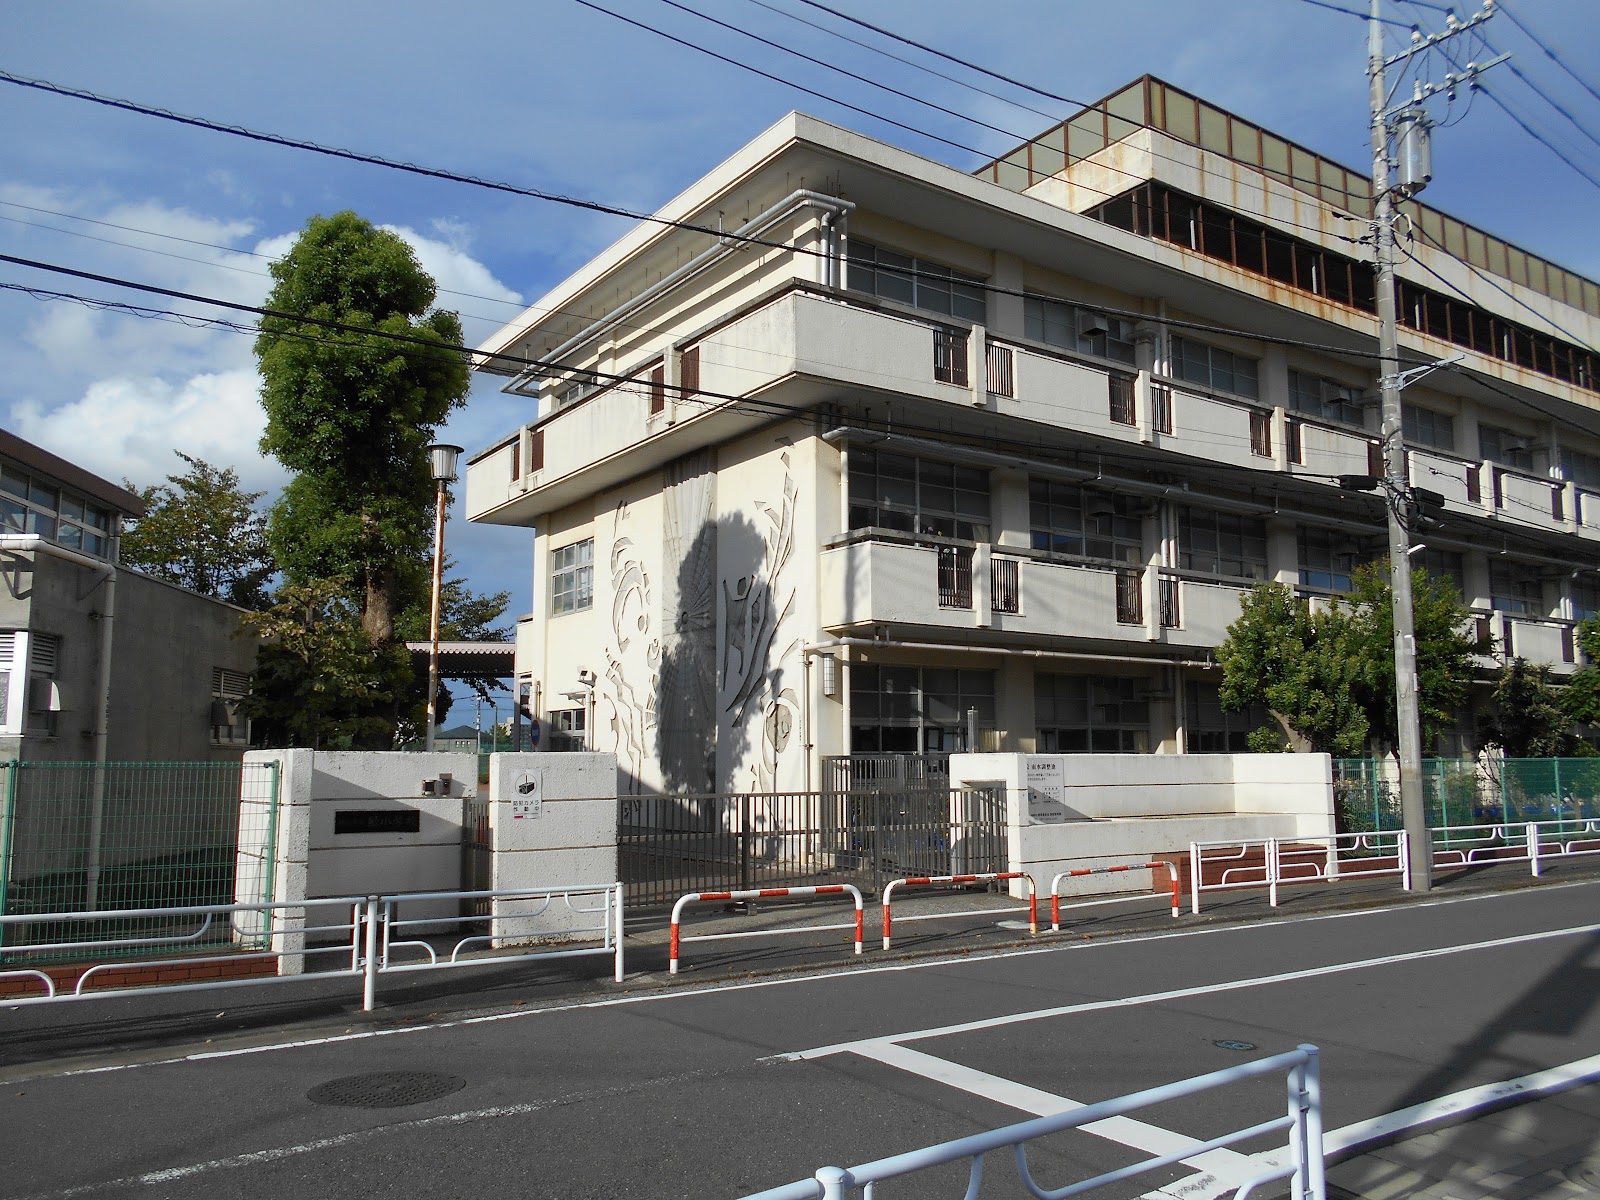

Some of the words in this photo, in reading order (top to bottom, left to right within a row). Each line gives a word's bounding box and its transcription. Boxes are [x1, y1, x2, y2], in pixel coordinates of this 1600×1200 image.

[513, 799, 540, 807] 防犯カメラ
